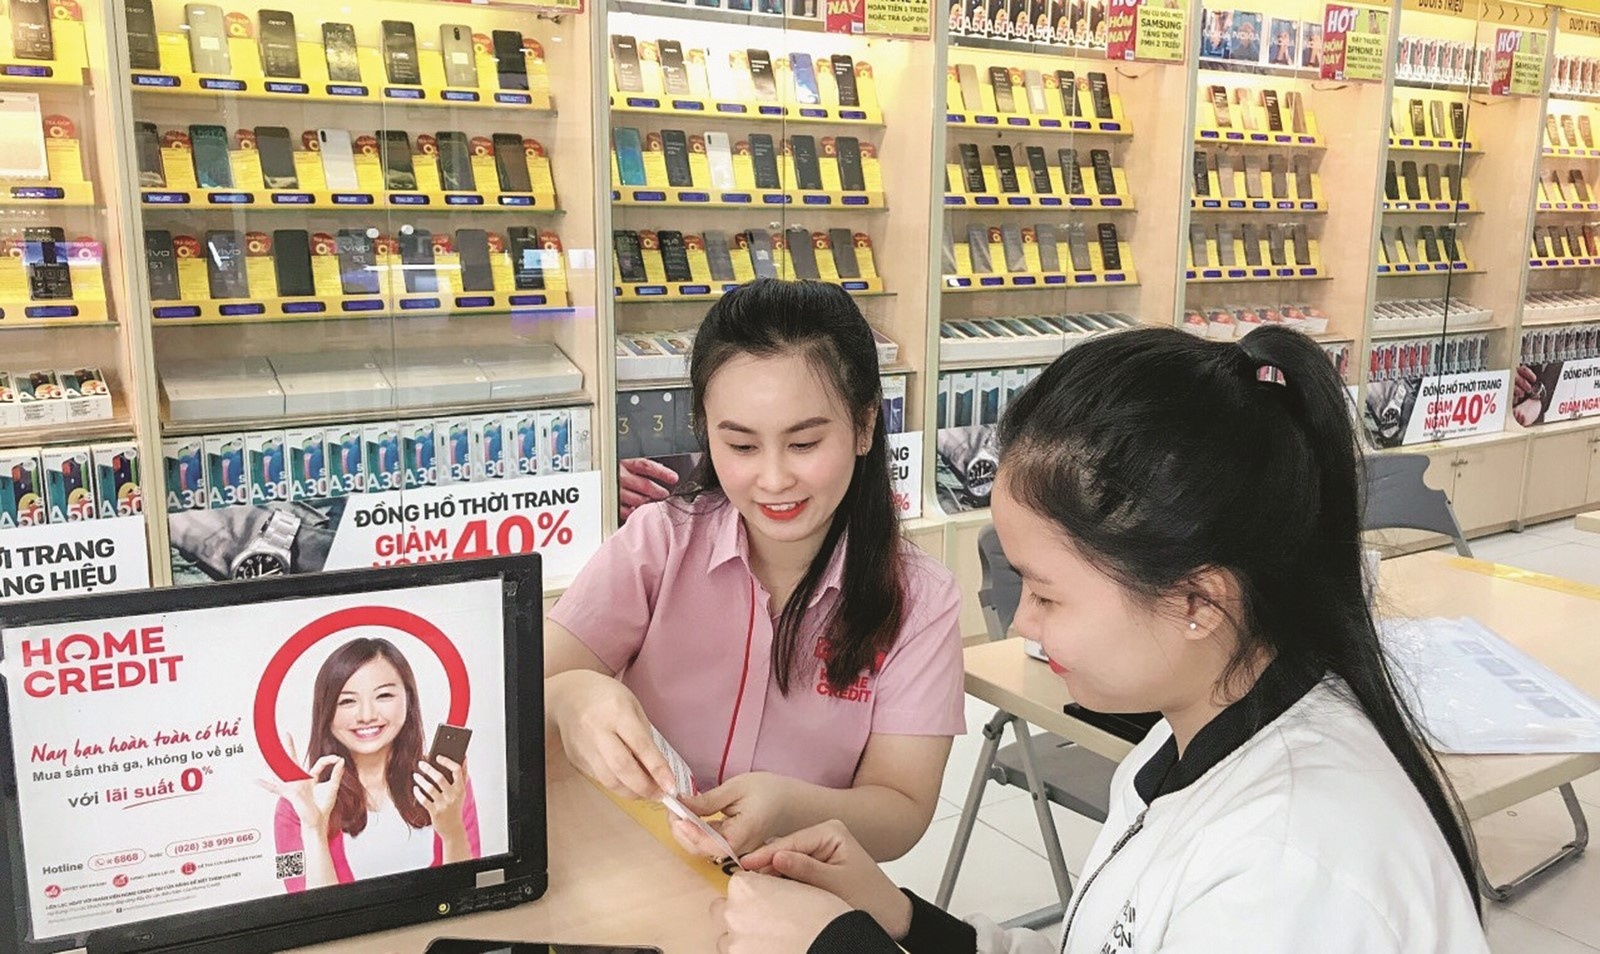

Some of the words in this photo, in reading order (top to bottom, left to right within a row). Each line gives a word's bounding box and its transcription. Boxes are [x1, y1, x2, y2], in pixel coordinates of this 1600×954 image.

[1141, 18, 1182, 30] SAMSUNG
[1327, 8, 1359, 33] HOT
[1108, 30, 1131, 43] NAY
[1498, 31, 1522, 52] HOT
[1423, 382, 1445, 397] ĐỒNG
[1446, 379, 1458, 394] HỒ
[1458, 380, 1475, 393] THỜI
[1477, 379, 1501, 391] TRANG
[1427, 397, 1453, 415] GIẢM
[1452, 392, 1497, 425] 40%
[618, 417, 629, 434] 3
[653, 415, 663, 431] 3
[1424, 415, 1451, 430] NGAY
[354, 501, 420, 528] ĐỒNG
[424, 494, 456, 520] HỒ
[458, 490, 509, 516] THỜI
[512, 487, 580, 511] TRANG
[375, 525, 448, 557] GIẢM
[452, 509, 573, 560] 40%
[16, 538, 115, 567] TRANG
[50, 563, 117, 592] HIỆU
[22, 626, 165, 667] HOME
[24, 656, 183, 698] CREDIT
[31, 743, 67, 766] Nay
[73, 738, 104, 759] bạn
[109, 734, 149, 753] hoàn
[154, 728, 190, 747] toàn
[195, 725, 211, 740] có
[215, 717, 242, 737] thể
[33, 770, 61, 782] Mua
[65, 763, 94, 778] sắm
[97, 760, 118, 774] thả
[123, 761, 143, 773] ga,
[146, 751, 188, 767] không
[191, 750, 203, 760] lo
[207, 744, 222, 758] về
[225, 743, 244, 760] giá
[68, 791, 99, 808] với
[106, 788, 128, 803] lãi
[134, 776, 175, 798] suất
[181, 765, 213, 792] 0%
[42, 862, 84, 875] Hotline
[174, 843, 199, 855] (028)
[202, 841, 214, 850] 38
[217, 837, 234, 847] 999
[236, 833, 254, 843] 666
